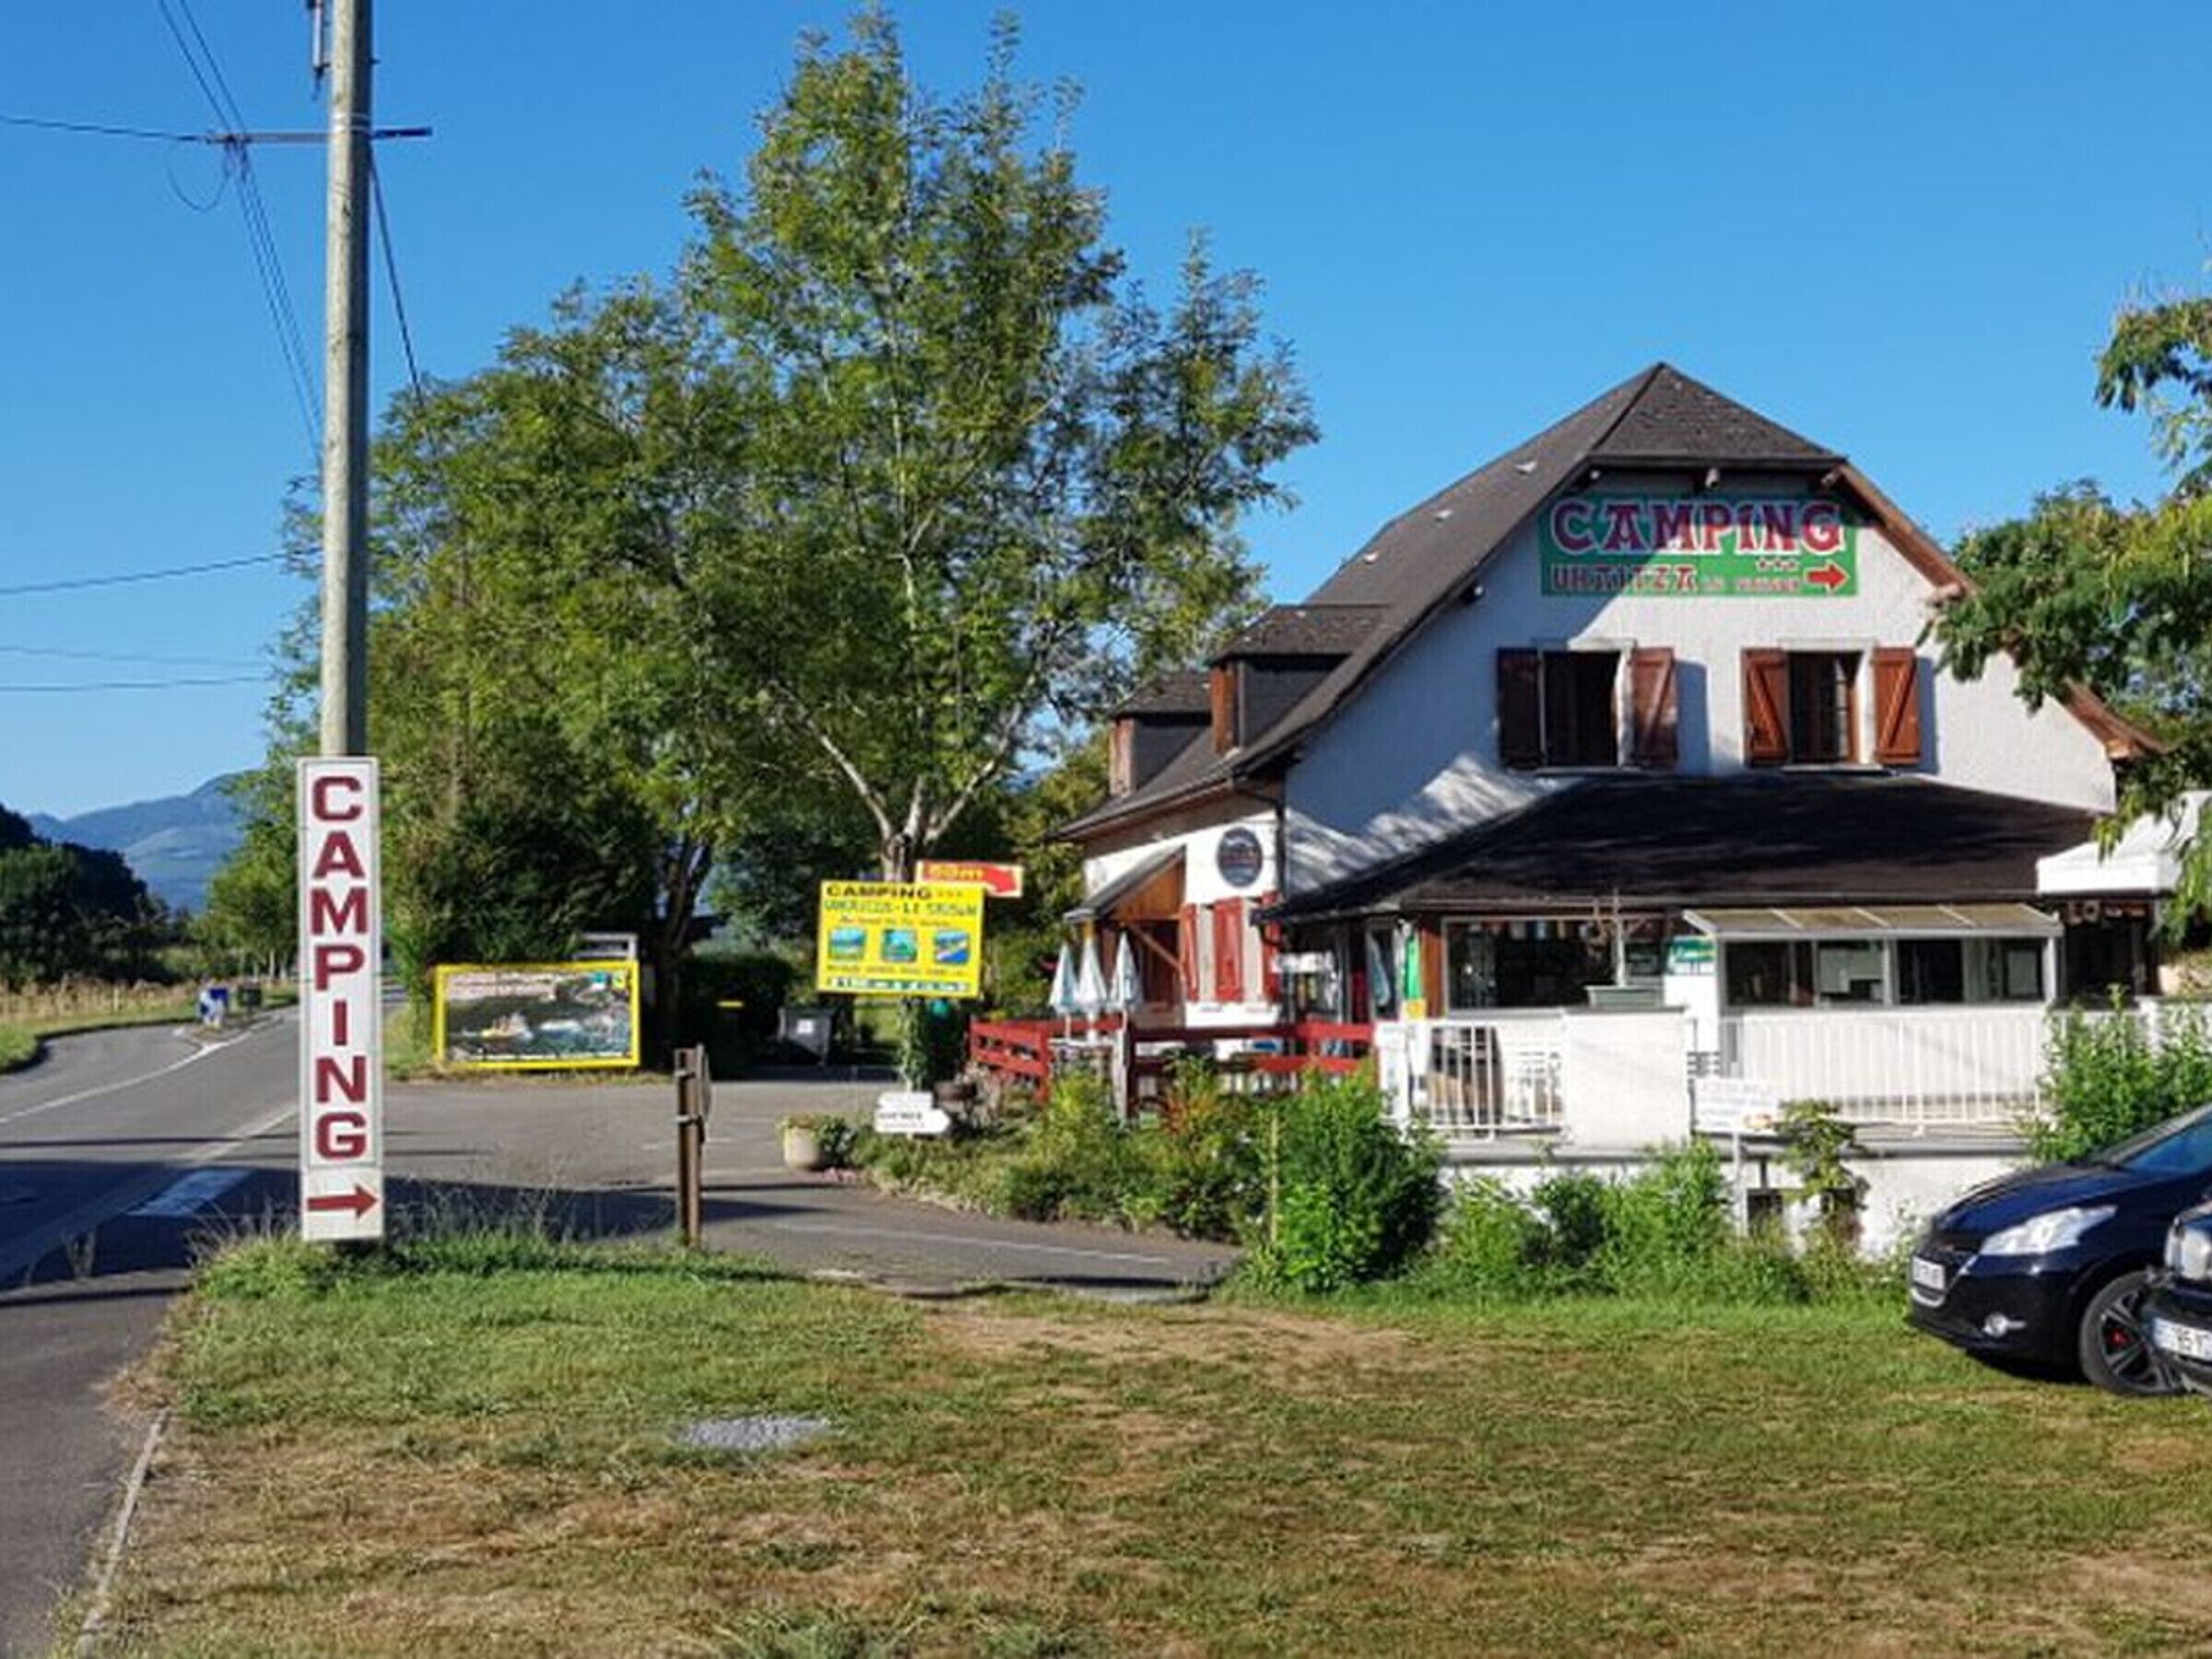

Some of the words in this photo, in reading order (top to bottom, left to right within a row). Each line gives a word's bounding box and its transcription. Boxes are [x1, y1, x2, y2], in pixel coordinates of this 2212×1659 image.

[1551, 499, 1845, 554] CAMPING
[826, 883, 932, 900] CAMPING
[311, 775, 368, 1159] CAMPING
